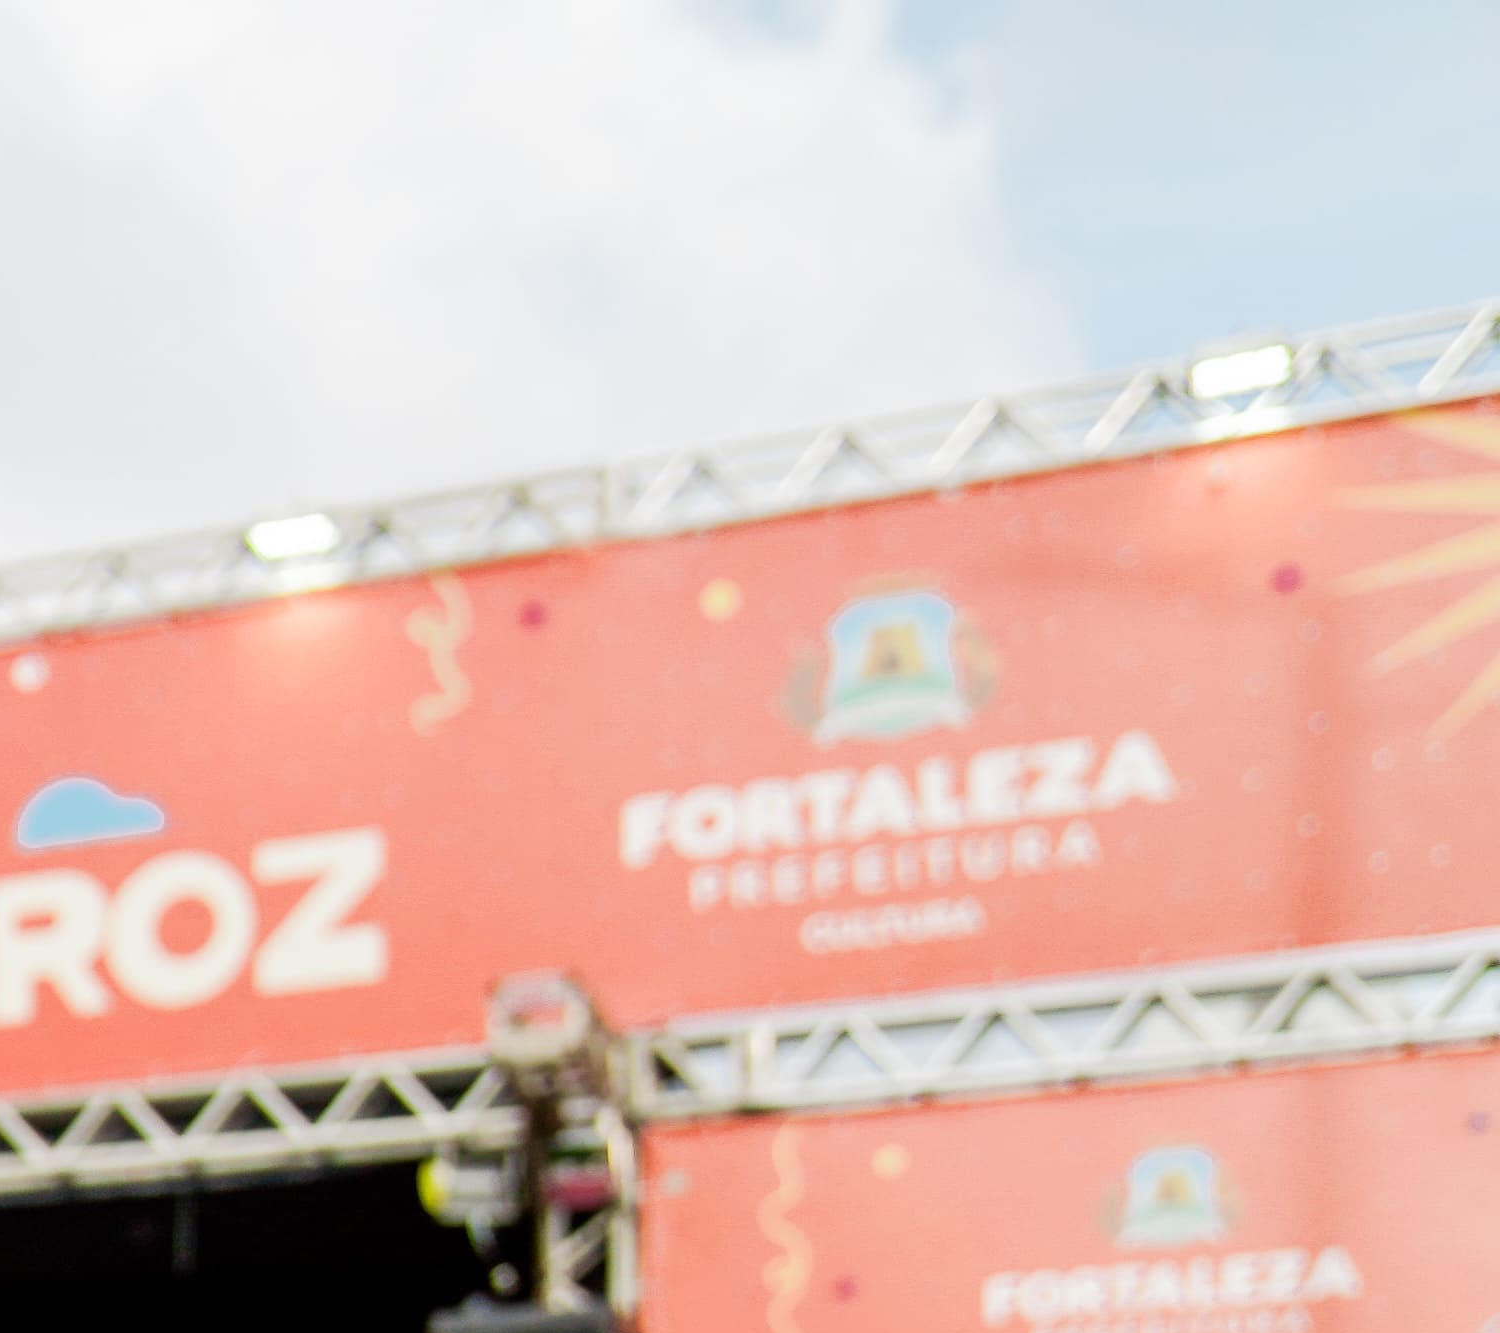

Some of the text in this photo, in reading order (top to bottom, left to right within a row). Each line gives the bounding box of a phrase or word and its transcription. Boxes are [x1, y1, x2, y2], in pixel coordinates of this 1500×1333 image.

[619, 730, 1176, 868] FORTALEZA
[688, 822, 1102, 910] PREFEITURA
[982, 1247, 1362, 1326] FORTALEZA
